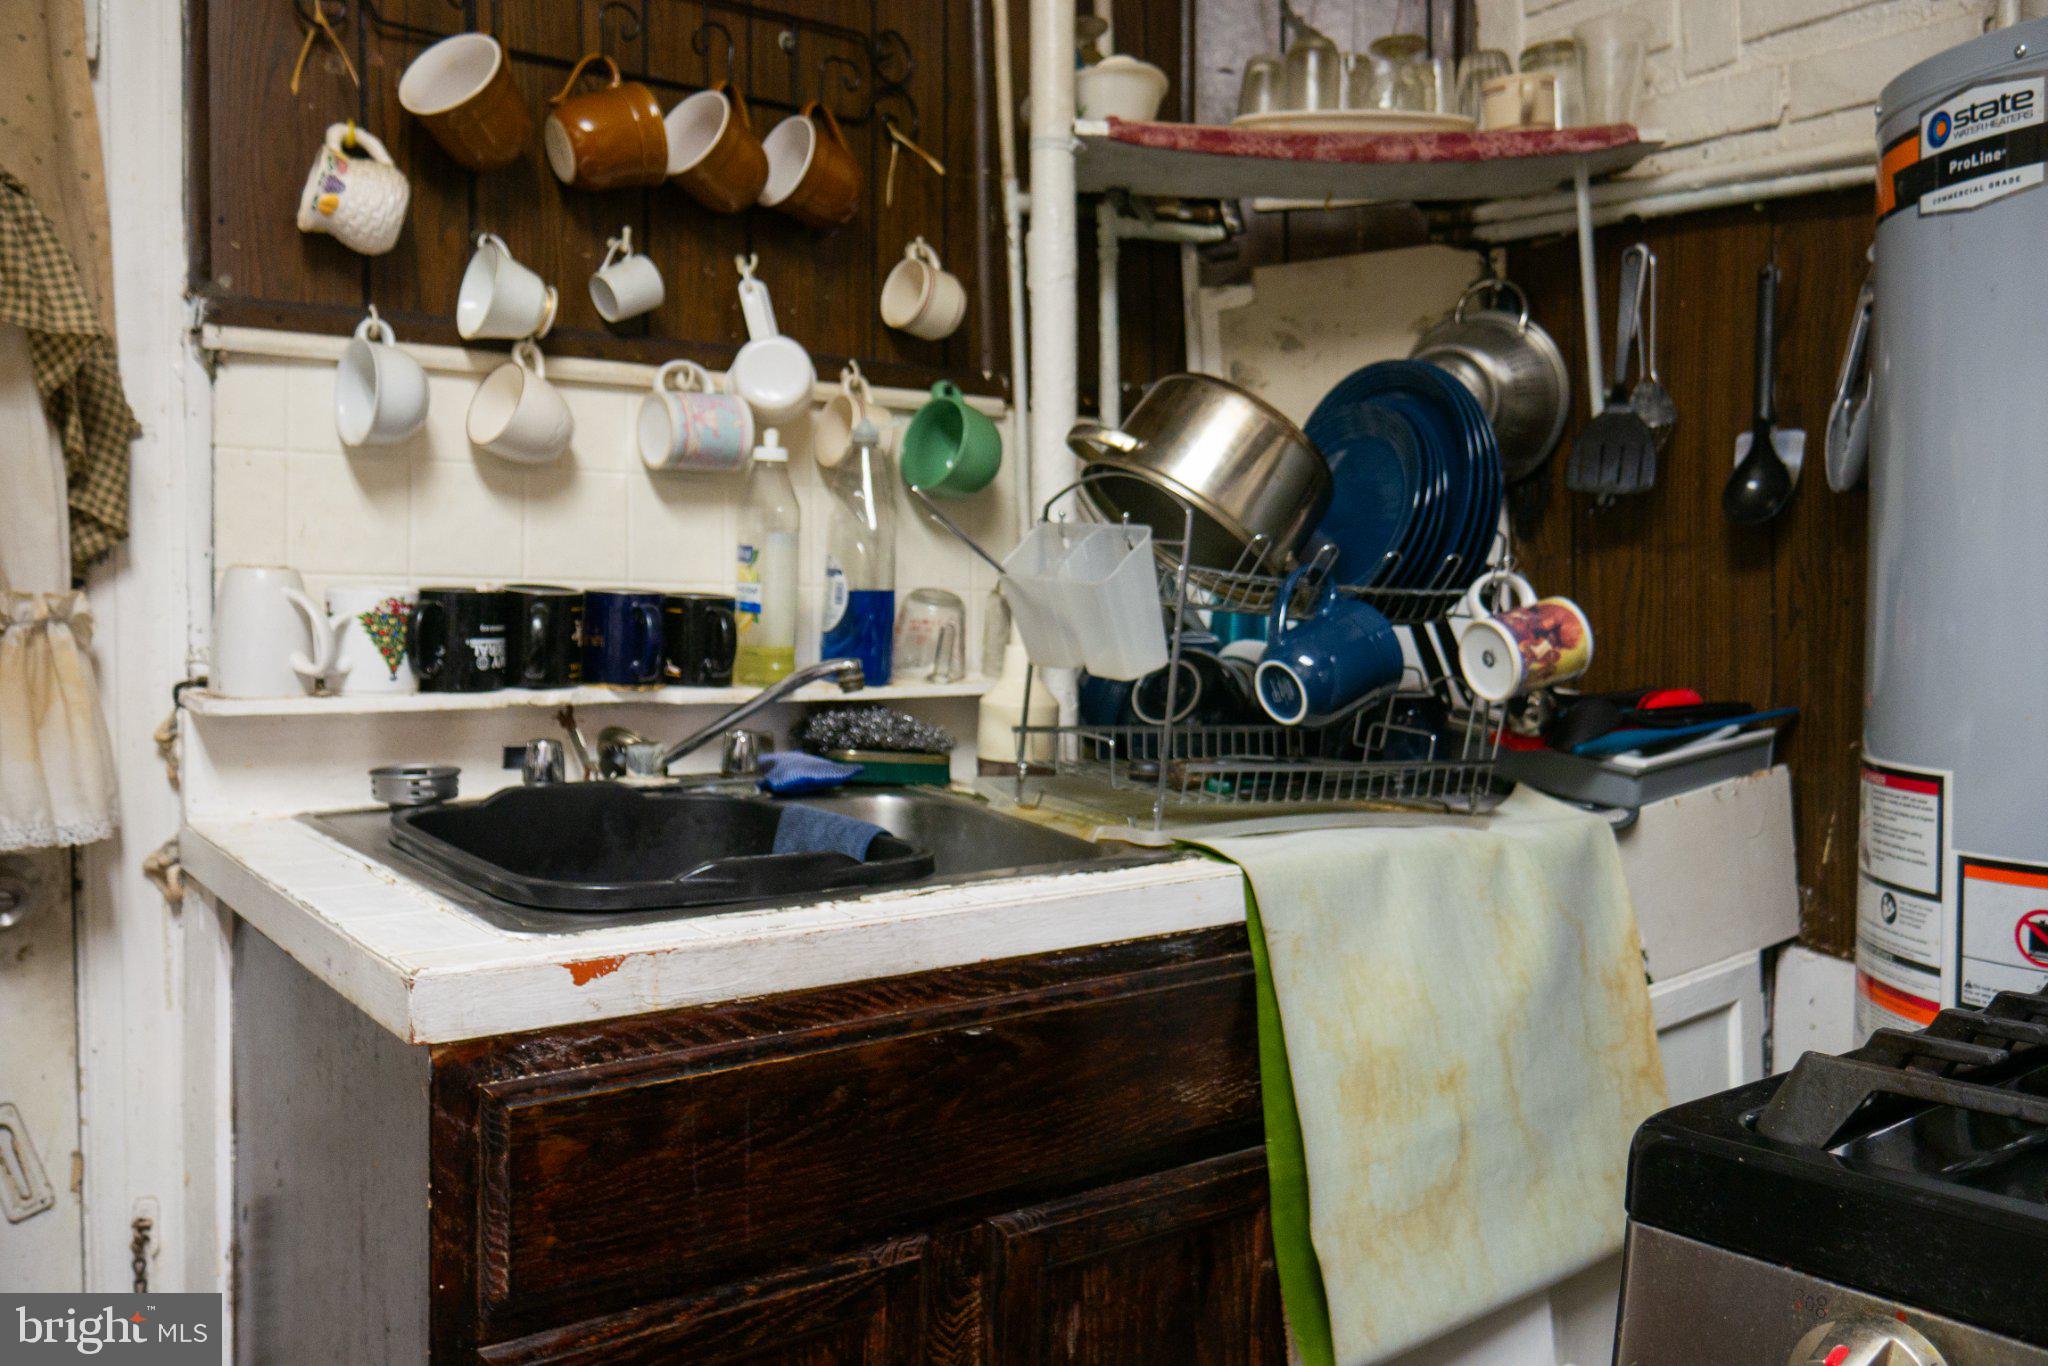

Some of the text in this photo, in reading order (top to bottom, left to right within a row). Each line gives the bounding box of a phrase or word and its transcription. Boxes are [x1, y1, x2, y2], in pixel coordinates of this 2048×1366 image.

[1953, 90, 2034, 130] state
[1949, 149, 2002, 175] ProLine
[1932, 175, 2021, 206] COMMERCIAL GRADE
